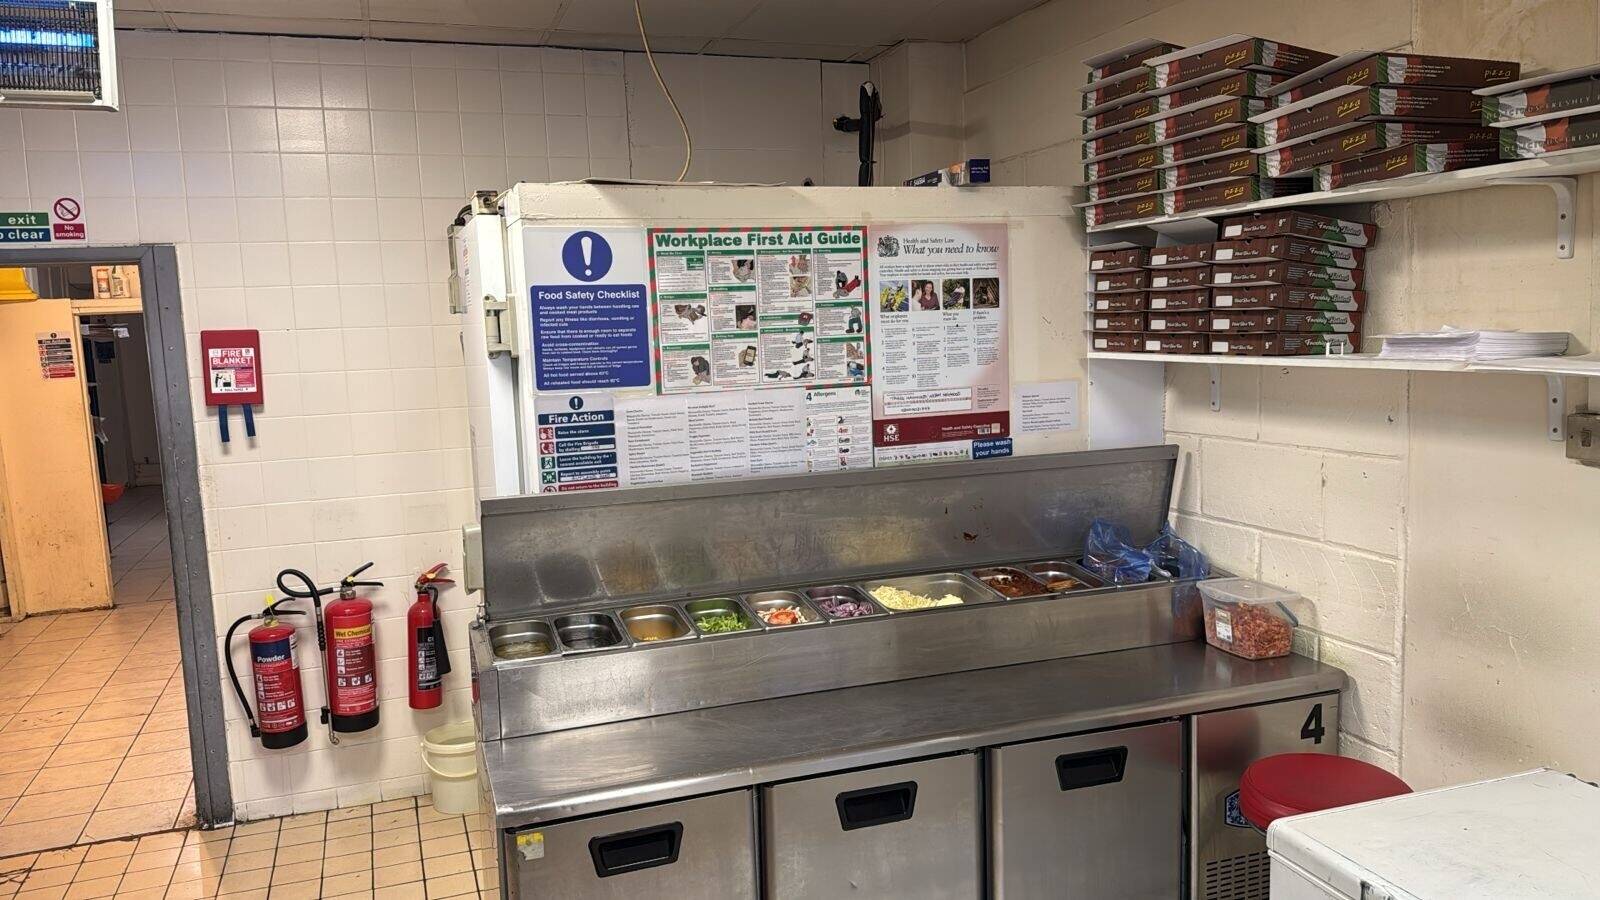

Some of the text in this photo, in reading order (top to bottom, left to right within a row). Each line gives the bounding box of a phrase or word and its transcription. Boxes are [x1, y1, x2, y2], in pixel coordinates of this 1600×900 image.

[1224, 48, 1247, 64] pizza
[1346, 68, 1369, 85] pizza
[1484, 68, 1511, 79] pizza
[1220, 82, 1241, 95] pizza
[1337, 99, 1361, 114] pizza
[1214, 108, 1233, 120] pizza
[1221, 135, 1240, 146] pizza
[1342, 133, 1368, 149] pizza
[1229, 159, 1250, 171] pizza
[1385, 154, 1409, 169] pizza
[1224, 186, 1244, 198] pizza
[1137, 202, 1154, 213] pizza
[8, 214, 37, 225] exit
[8, 229, 44, 240] clear
[655, 232, 861, 249] Workplace First Aid Guide
[904, 243, 1000, 257] What you need to know
[538, 290, 641, 302] Food Safety Checklist
[222, 350, 242, 358] FIRE
[212, 357, 251, 366] BLANKET
[814, 391, 837, 399] Allergens
[549, 413, 605, 424] Fire Action
[884, 434, 900, 442] HSE
[995, 439, 1011, 447] wash
[976, 450, 990, 458] your
[991, 448, 1010, 456] hands
[335, 627, 371, 638] Wet Chemical
[257, 655, 286, 663] Powder
[1300, 703, 1325, 745] 4
